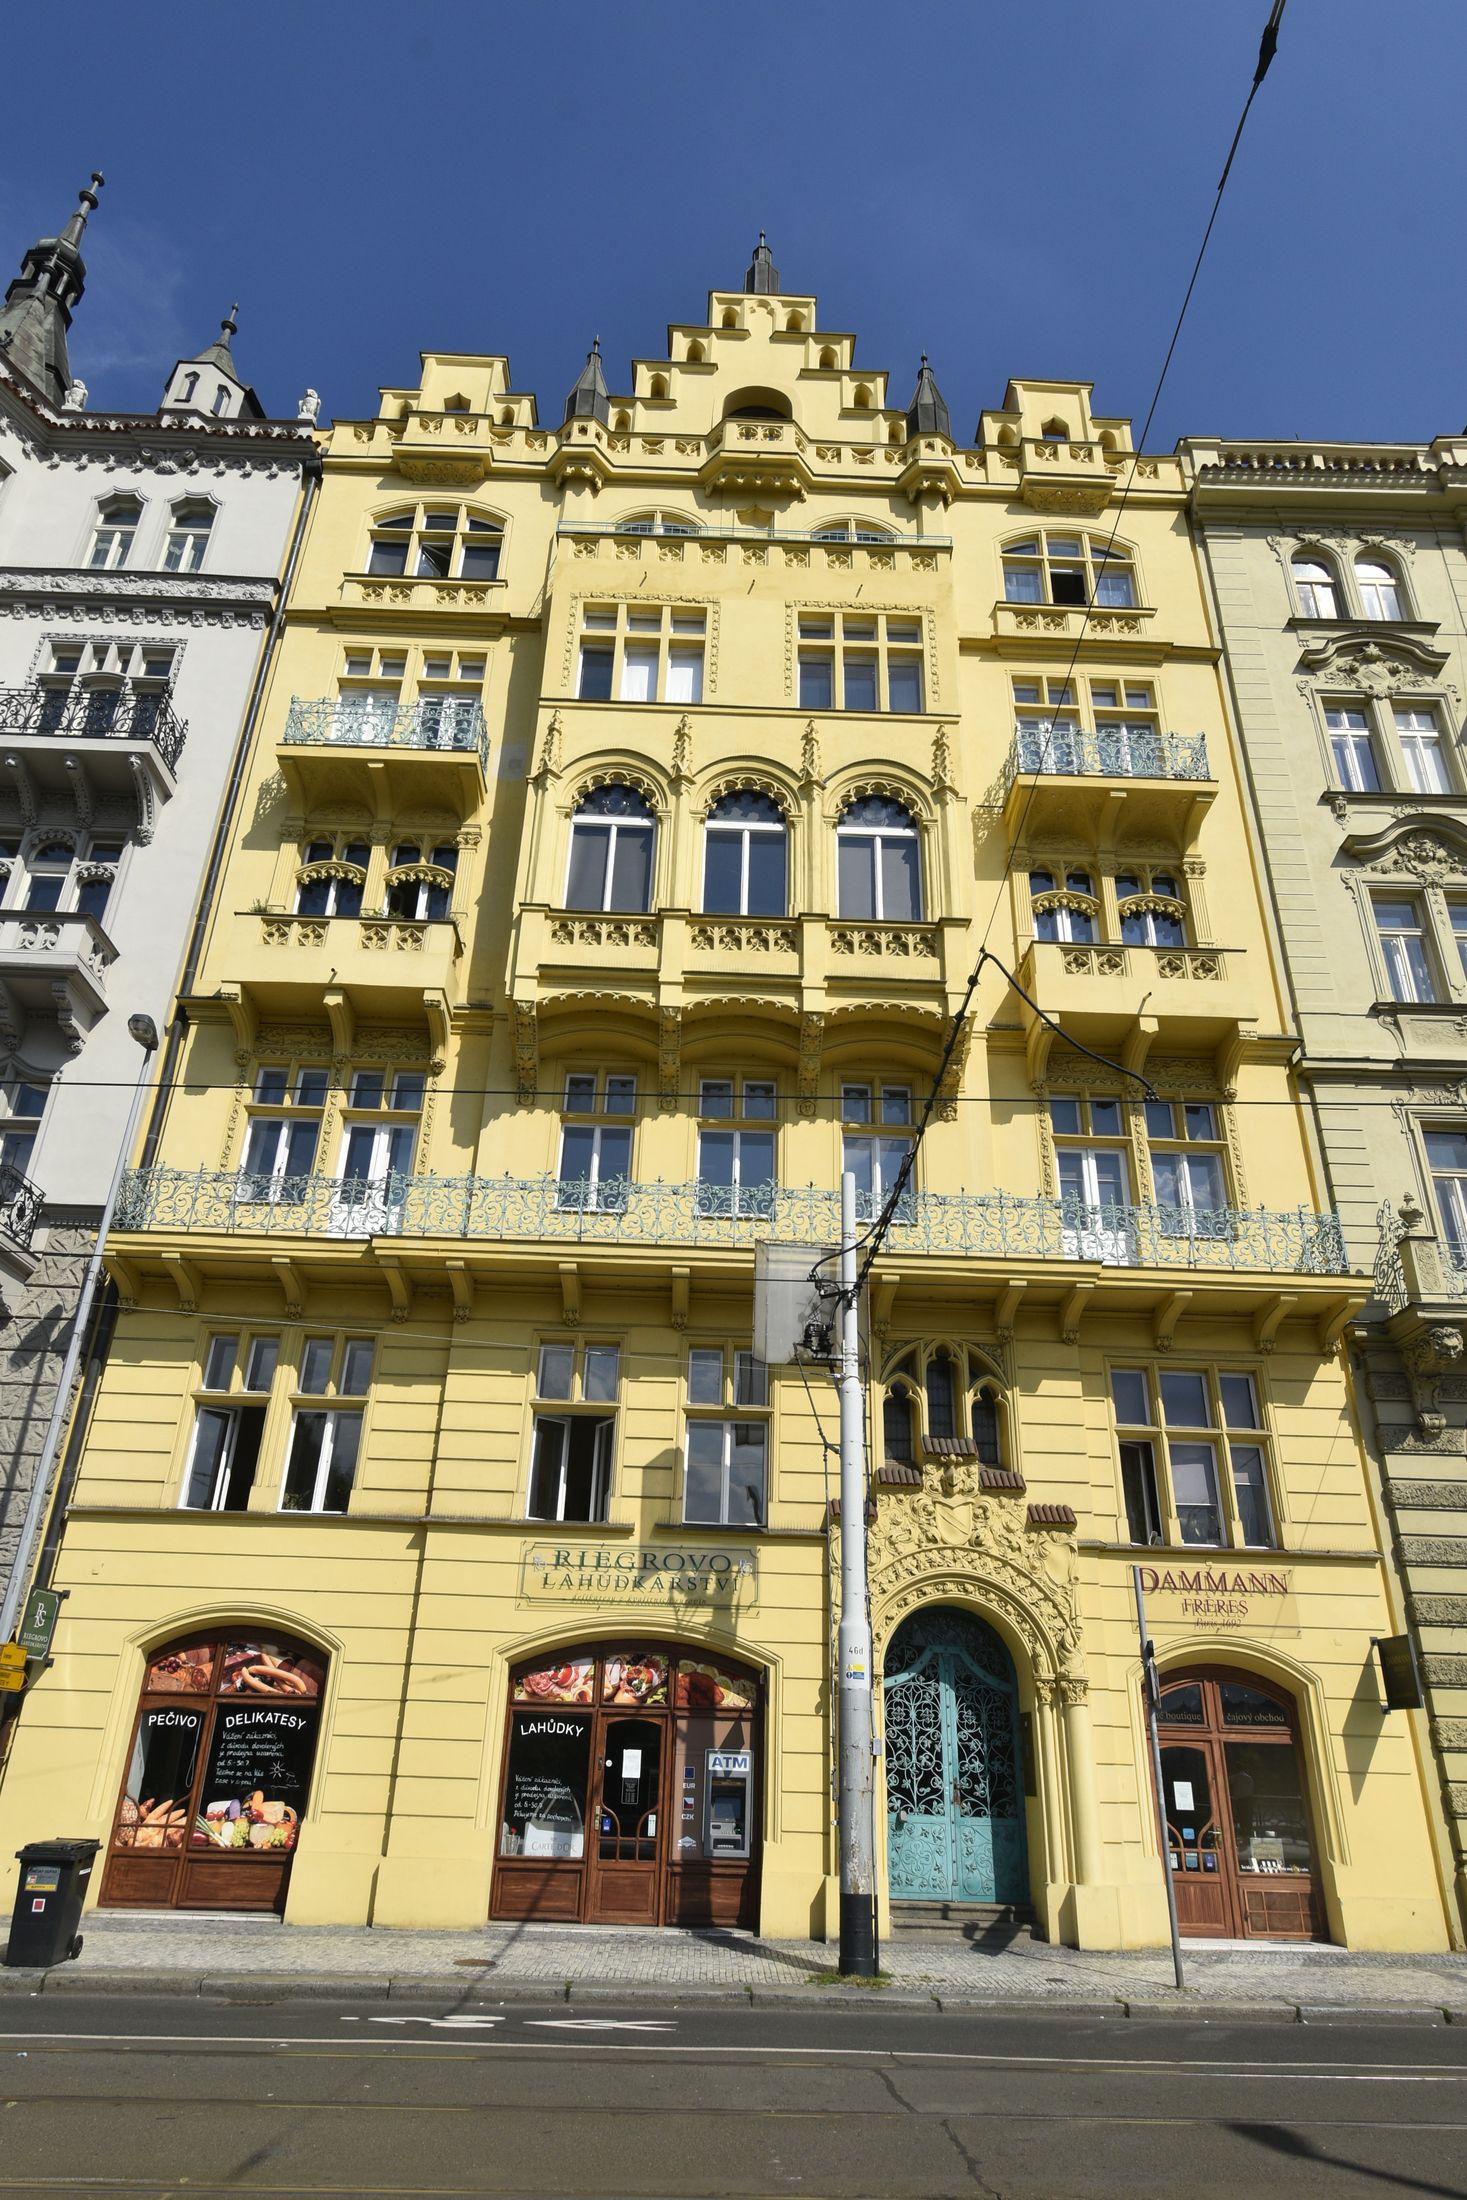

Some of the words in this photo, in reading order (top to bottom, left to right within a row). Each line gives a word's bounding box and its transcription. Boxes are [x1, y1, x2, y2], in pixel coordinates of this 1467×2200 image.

[554, 1549, 731, 1572] RIEGROVO
[1139, 1567, 1289, 1594] DAMMANN
[148, 1711, 197, 1728] PEČIVO
[225, 1712, 307, 1730] DELIKATESY
[1166, 1712, 1201, 1723] boutique
[1254, 1712, 1284, 1722] obchod
[520, 1718, 584, 1737] LAHŮDKY
[711, 1756, 748, 1769] ATM
